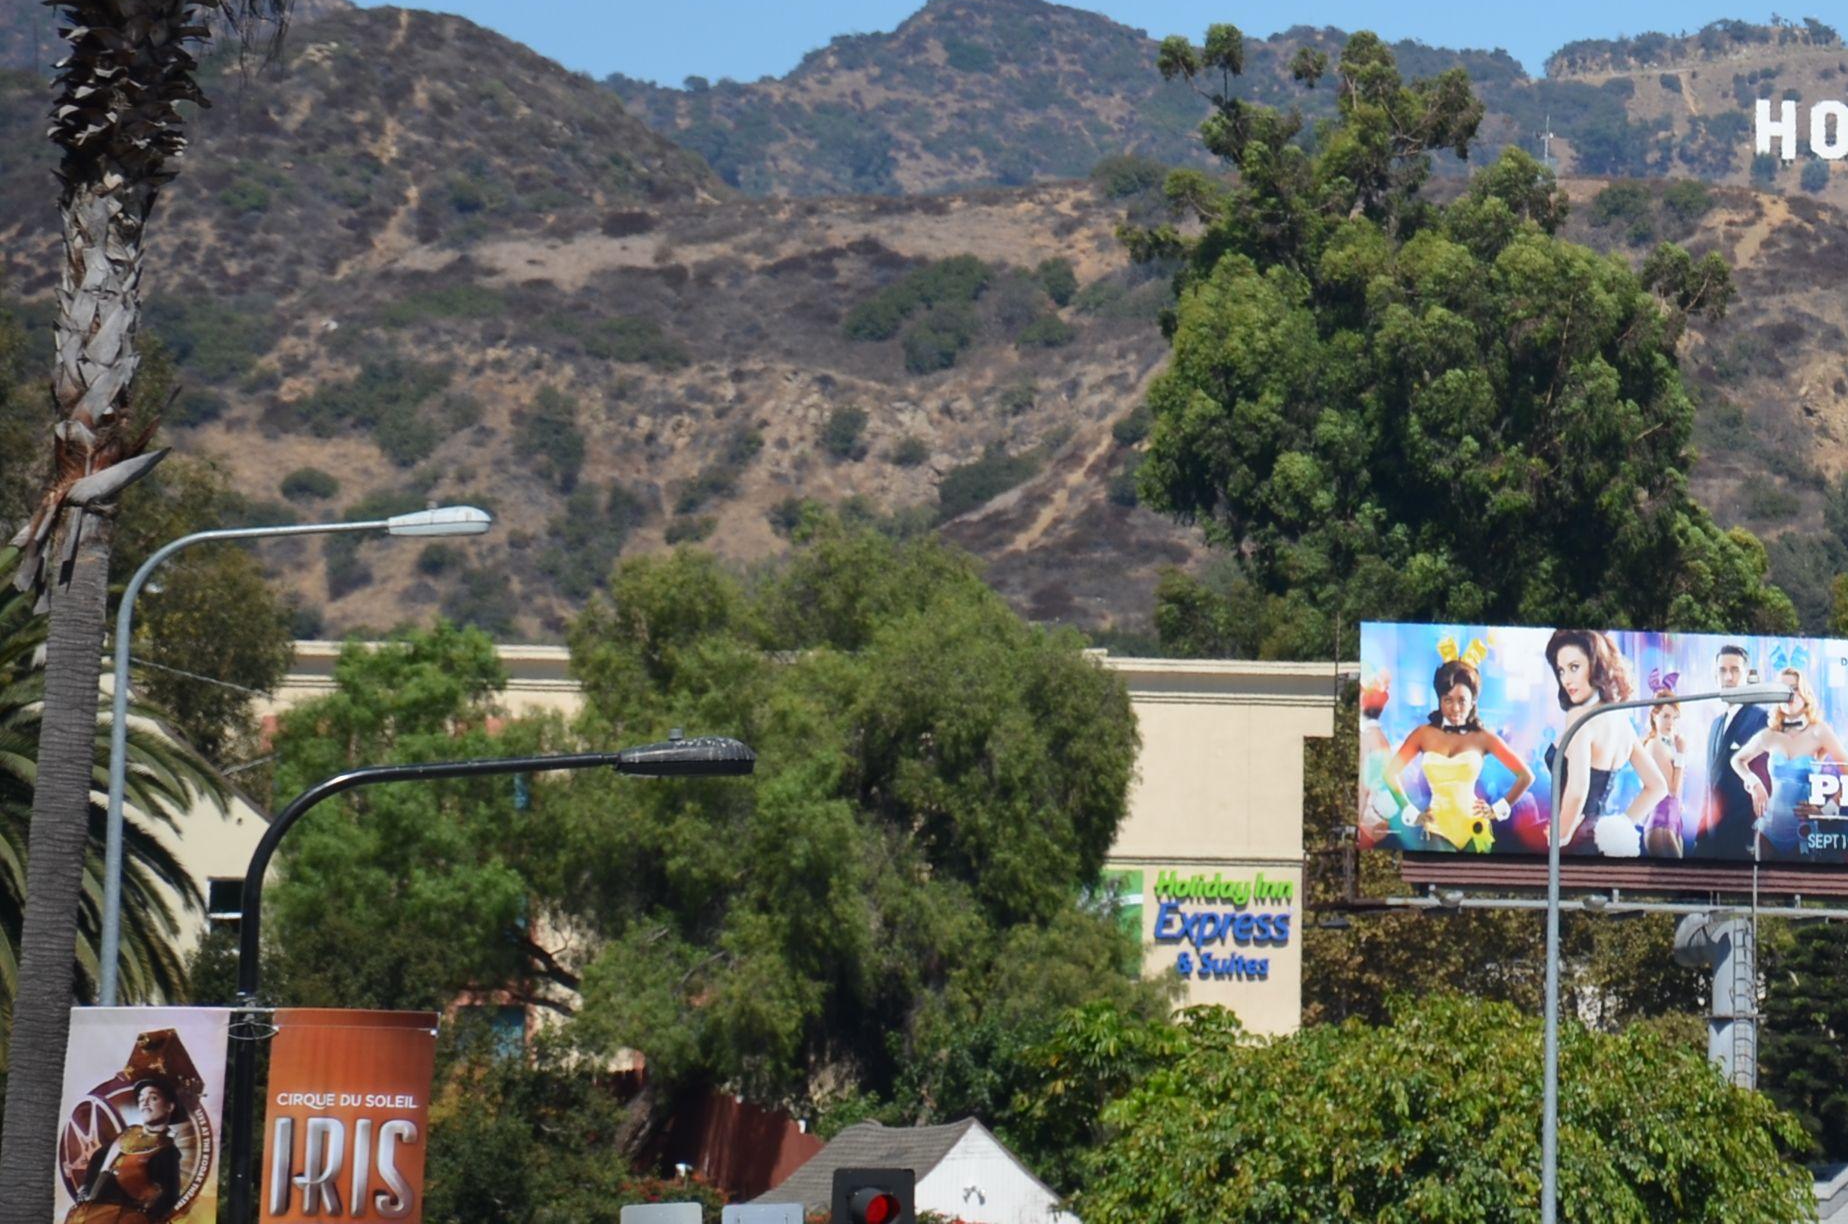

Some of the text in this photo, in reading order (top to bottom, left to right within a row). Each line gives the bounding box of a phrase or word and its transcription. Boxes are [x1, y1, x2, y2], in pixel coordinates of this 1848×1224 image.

[1808, 833, 1839, 850] SEPT
[1154, 871, 1294, 906] Holiday Inn
[1154, 901, 1291, 950] Express
[1177, 951, 1270, 979] & Suites
[276, 1092, 419, 1110] CIRQUE DU SOLEIL
[269, 1117, 418, 1218] IRIS
